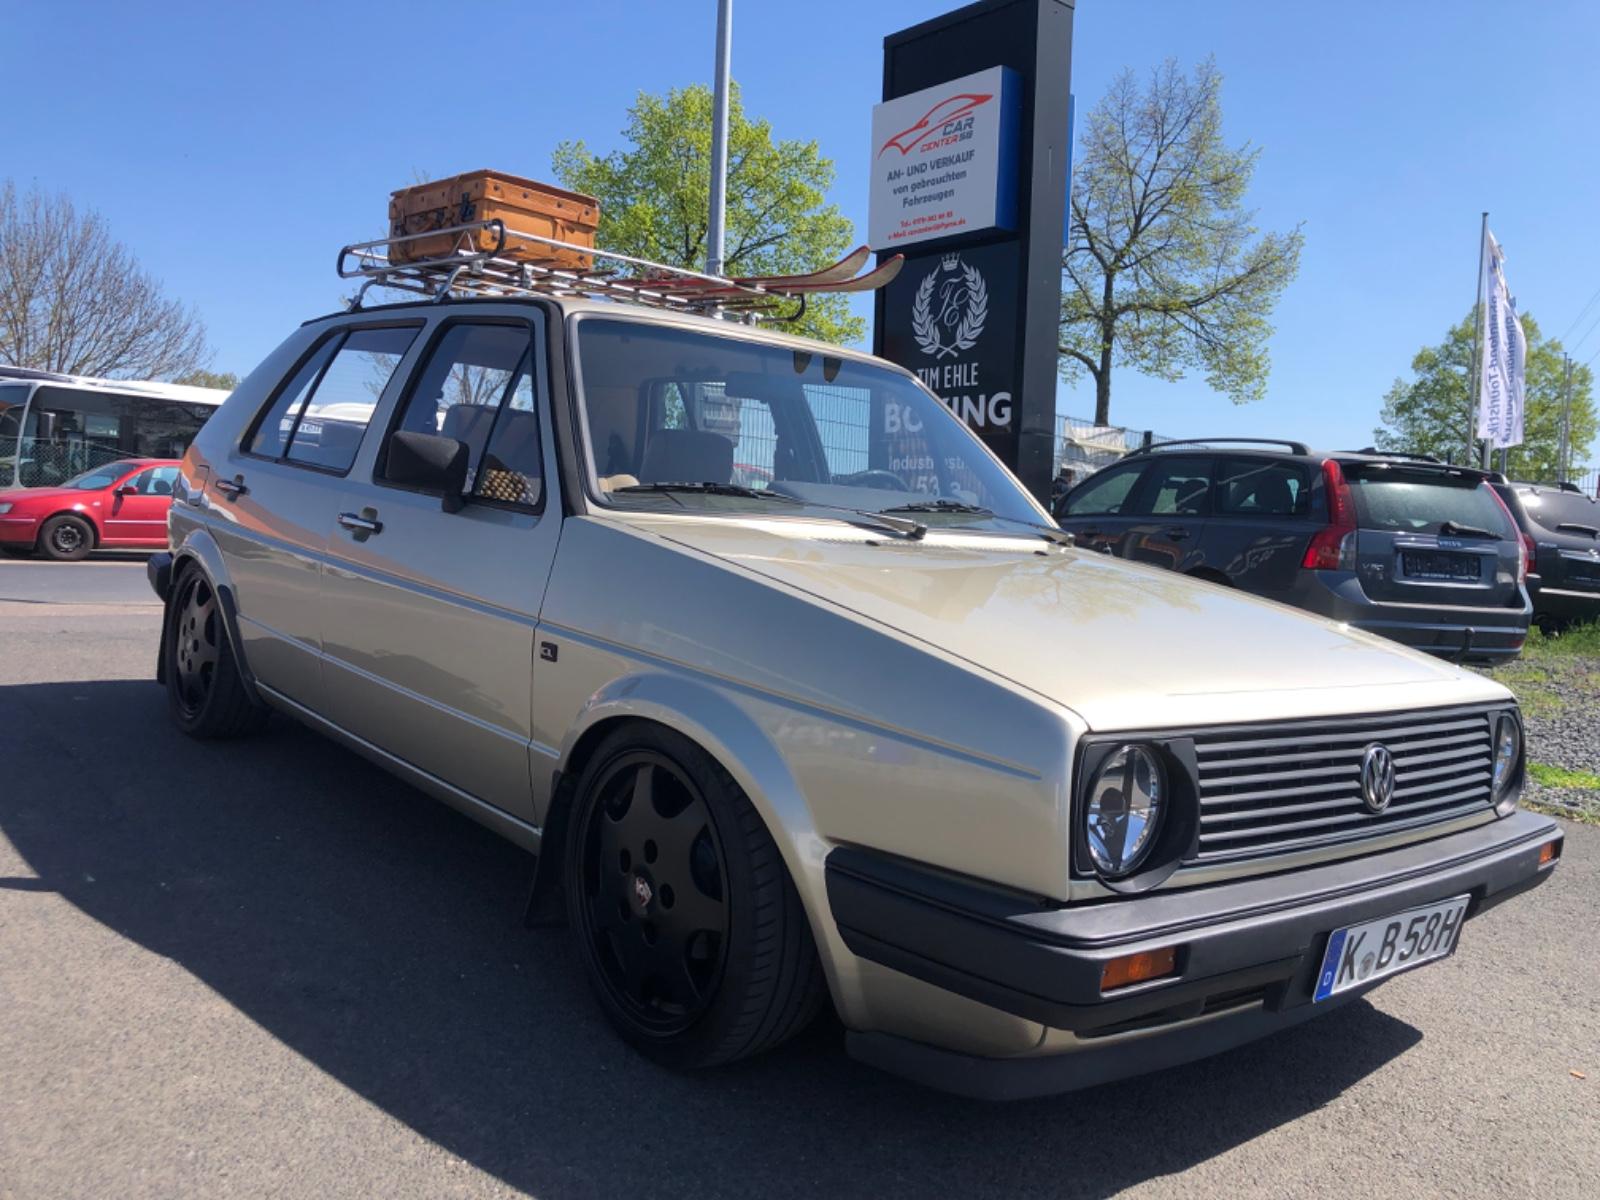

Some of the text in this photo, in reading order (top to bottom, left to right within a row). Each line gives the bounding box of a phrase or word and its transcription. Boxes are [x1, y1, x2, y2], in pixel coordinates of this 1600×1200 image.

[942, 116, 975, 136] CAR
[920, 134, 959, 153] CENTER
[887, 149, 976, 182] AN- UND VERKAUF
[892, 169, 968, 196] von gebrauchten
[902, 188, 955, 209] Fahrzeugen
[943, 362, 979, 389] EHLE
[1338, 931, 1367, 985] K
